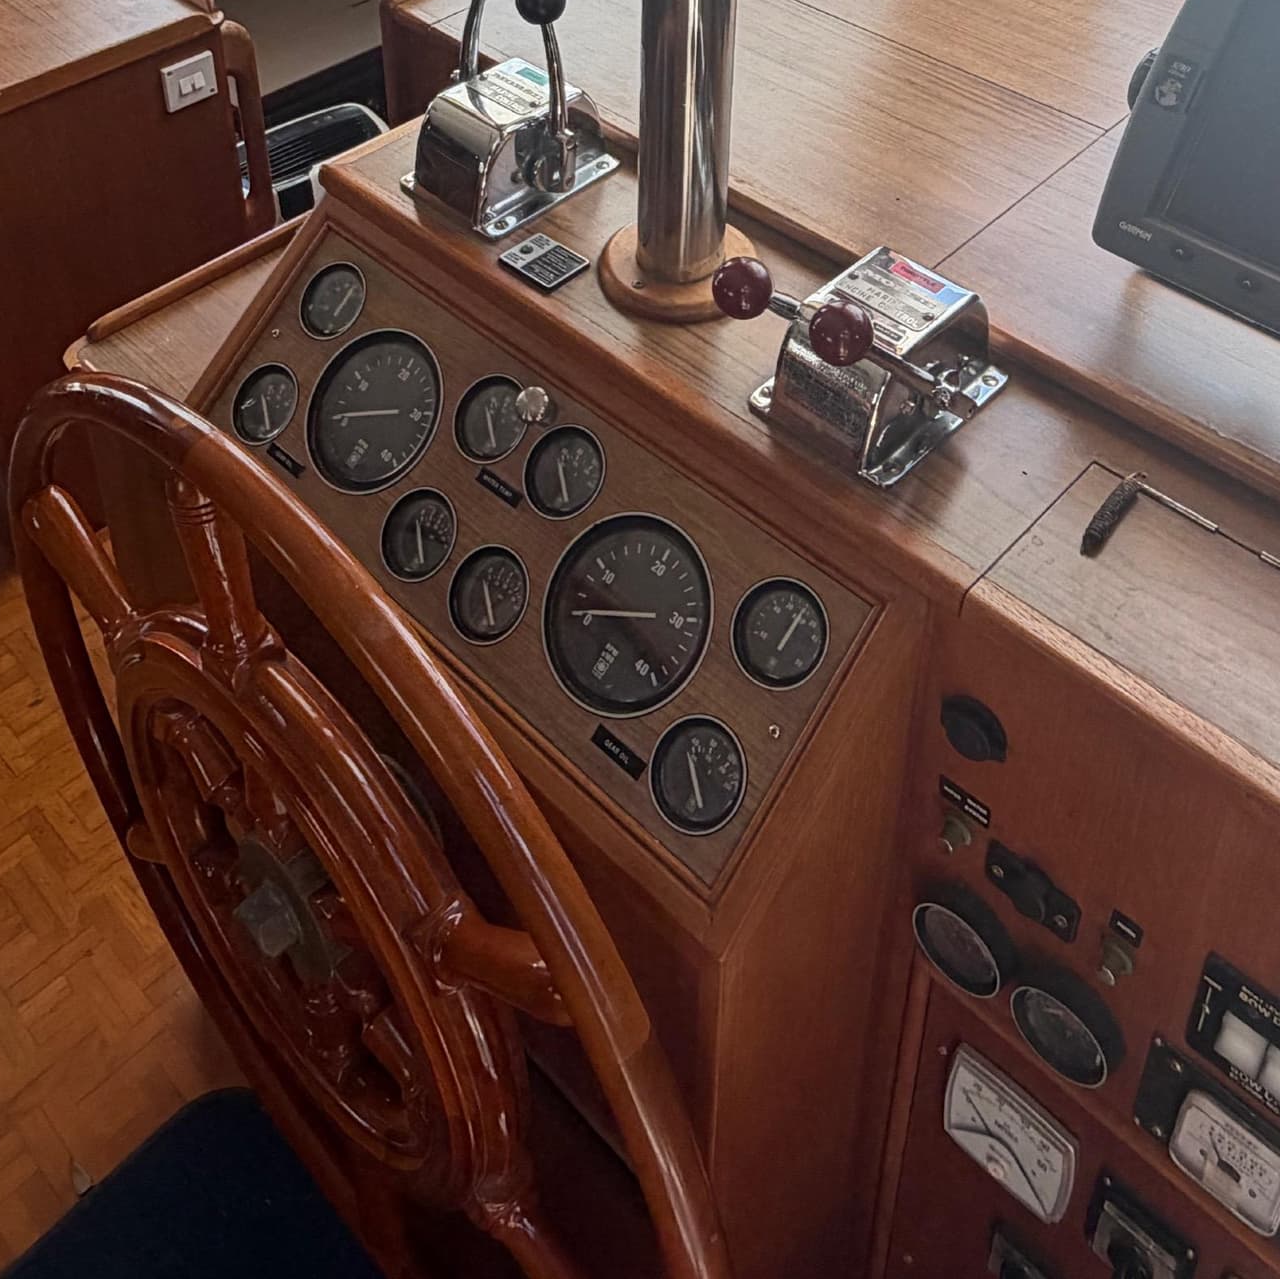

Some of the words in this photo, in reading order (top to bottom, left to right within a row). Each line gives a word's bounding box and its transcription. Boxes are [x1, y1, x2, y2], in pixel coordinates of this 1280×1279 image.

[601, 569, 615, 585] 10
[650, 560, 667, 577] 20
[669, 611, 685, 629] 30
[634, 658, 650, 677] 40
[1238, 991, 1271, 1021] BOW
